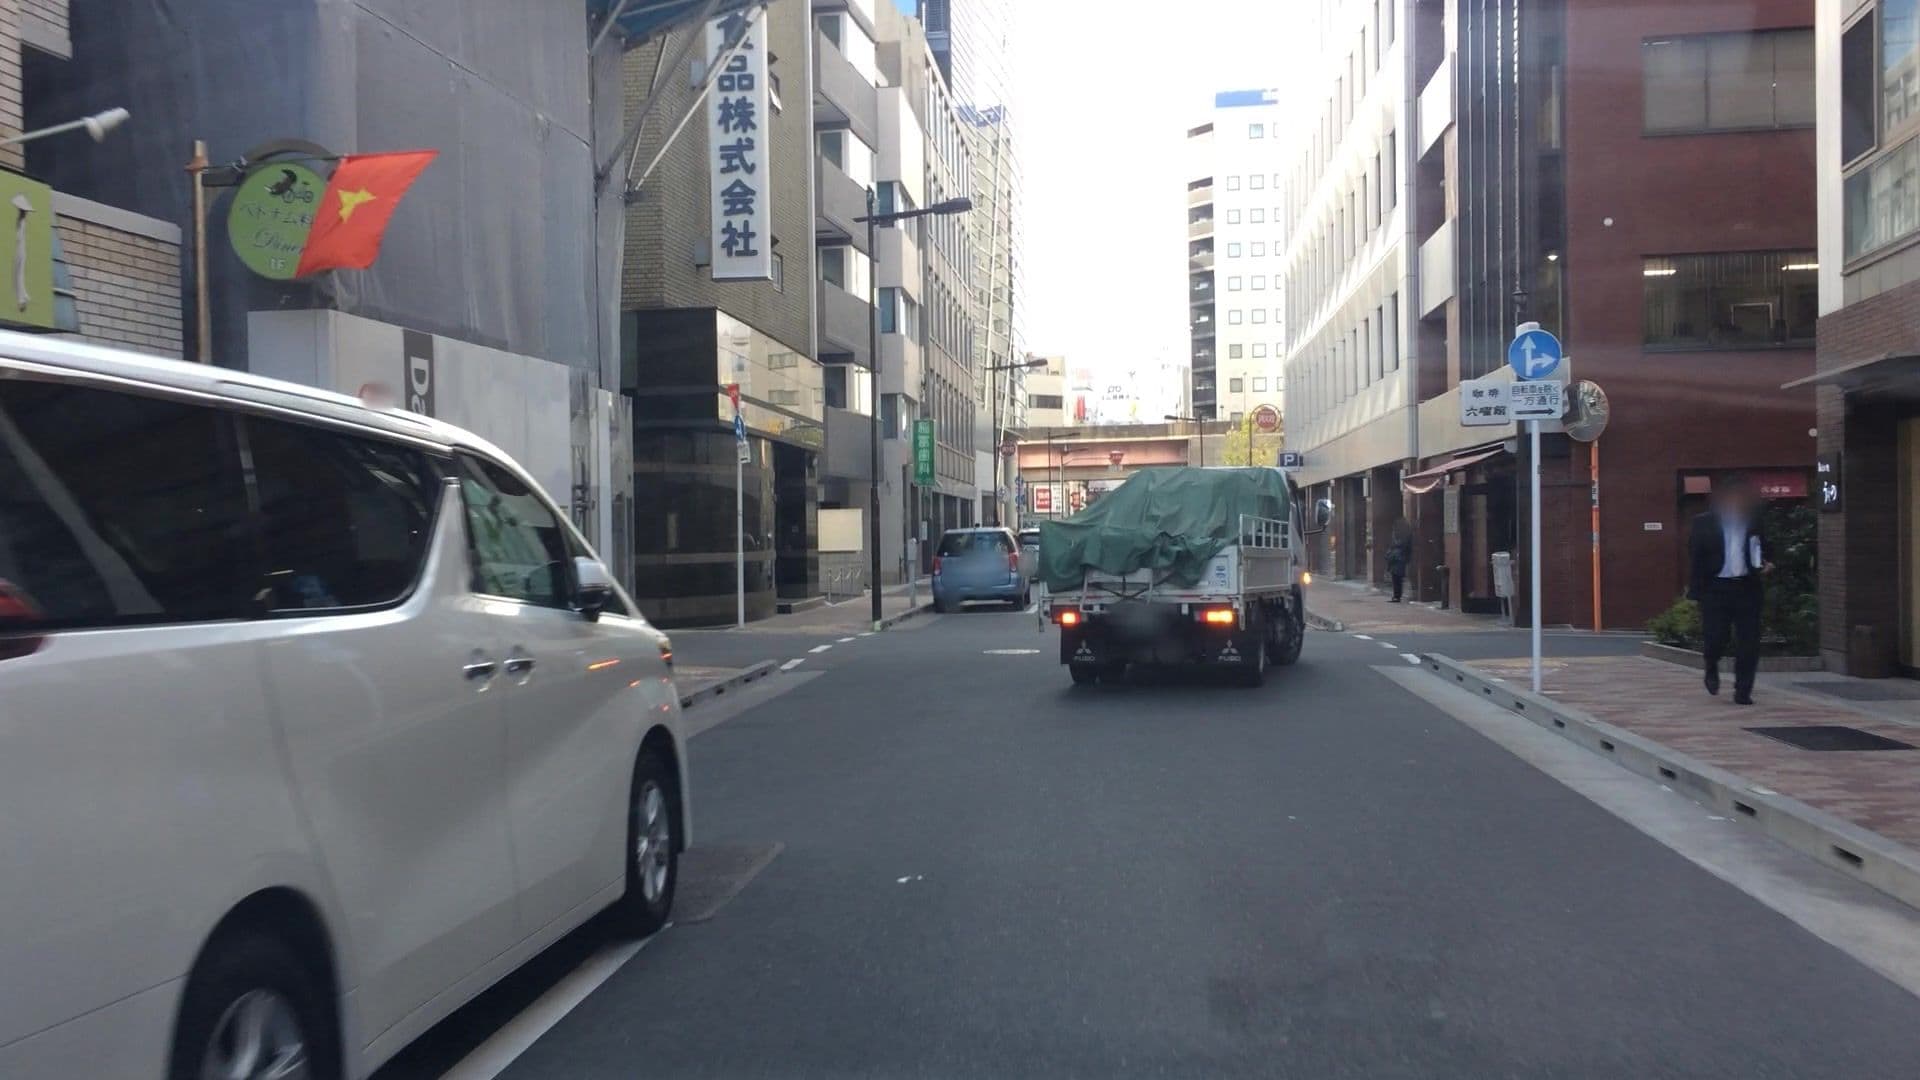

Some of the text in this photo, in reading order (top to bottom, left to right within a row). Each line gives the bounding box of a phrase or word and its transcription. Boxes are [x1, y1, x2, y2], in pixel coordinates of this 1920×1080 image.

[1511, 384, 1559, 395] 自転車を除く
[1511, 396, 1559, 405] 一方通行
[1283, 454, 1295, 466] P
